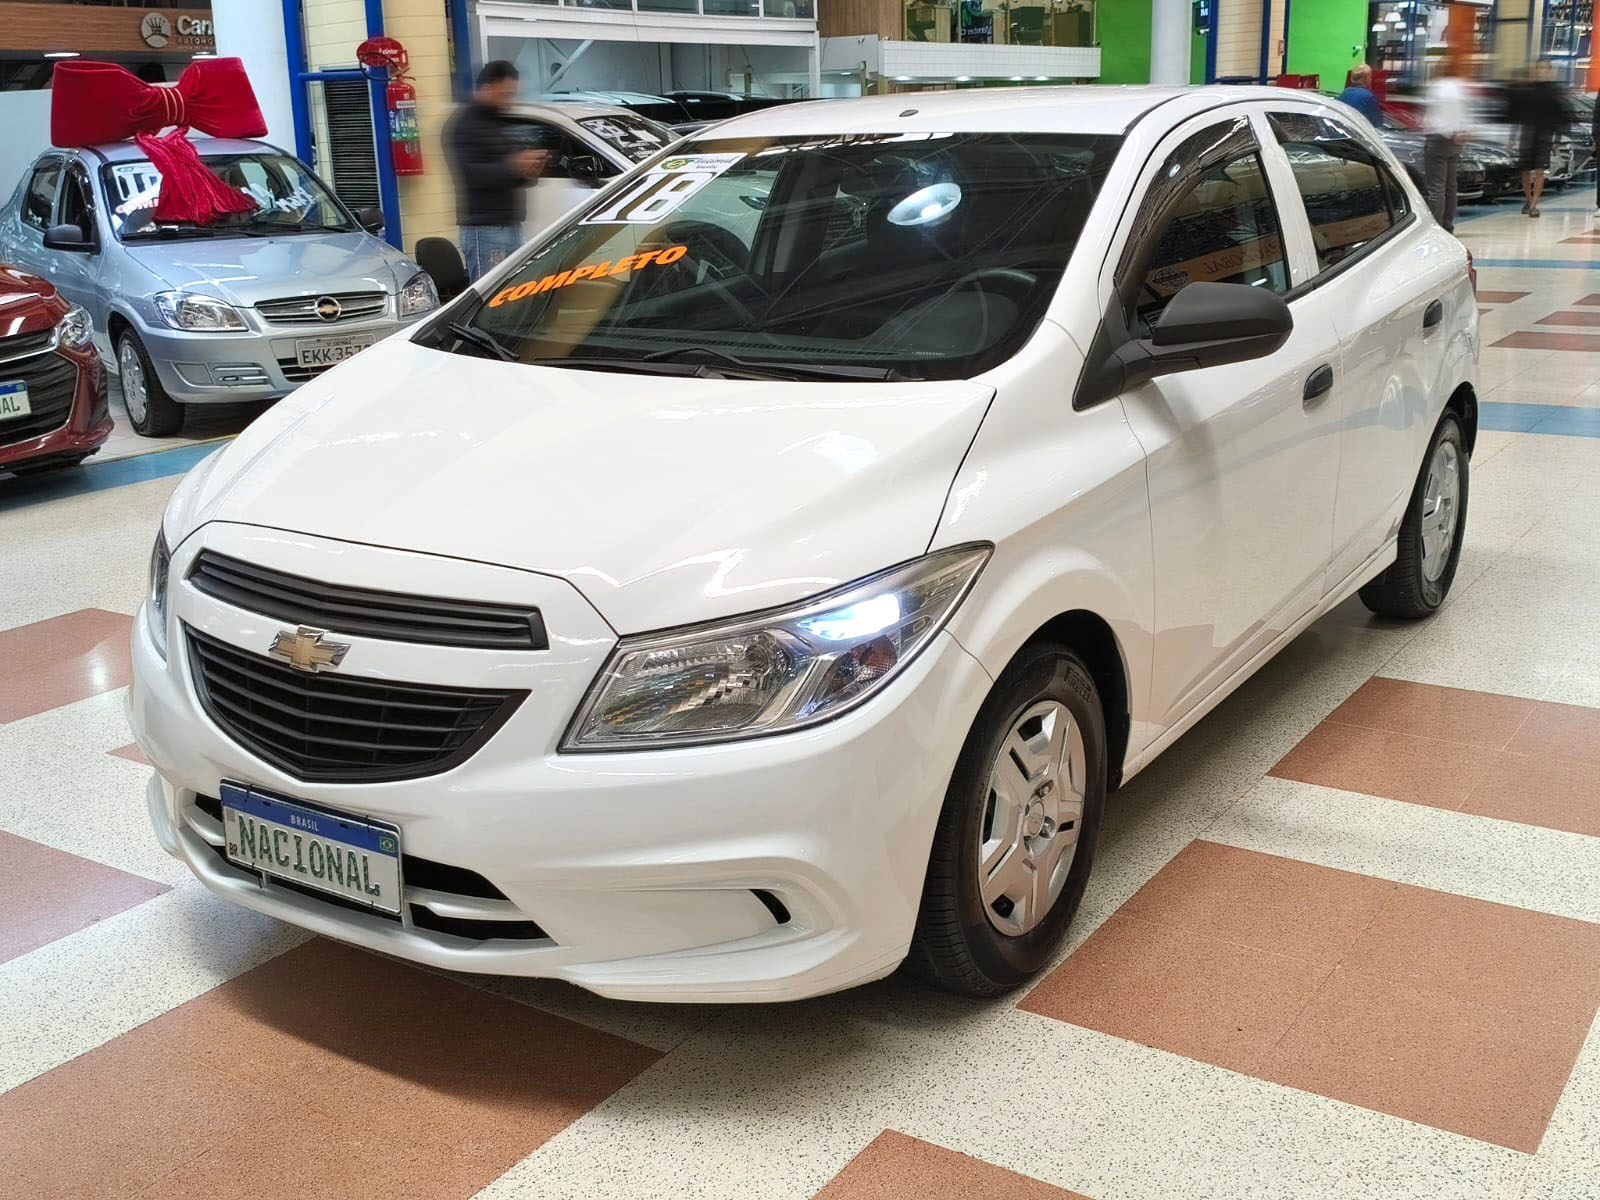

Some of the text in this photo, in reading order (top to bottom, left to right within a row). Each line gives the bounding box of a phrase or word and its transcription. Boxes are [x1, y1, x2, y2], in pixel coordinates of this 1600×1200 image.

[590, 172, 715, 221] 18
[488, 245, 688, 308] COMPLETO
[0, 396, 21, 414] AL
[290, 814, 319, 832] BRASIL
[228, 842, 239, 857] BR
[238, 813, 380, 897] NACIONAL
